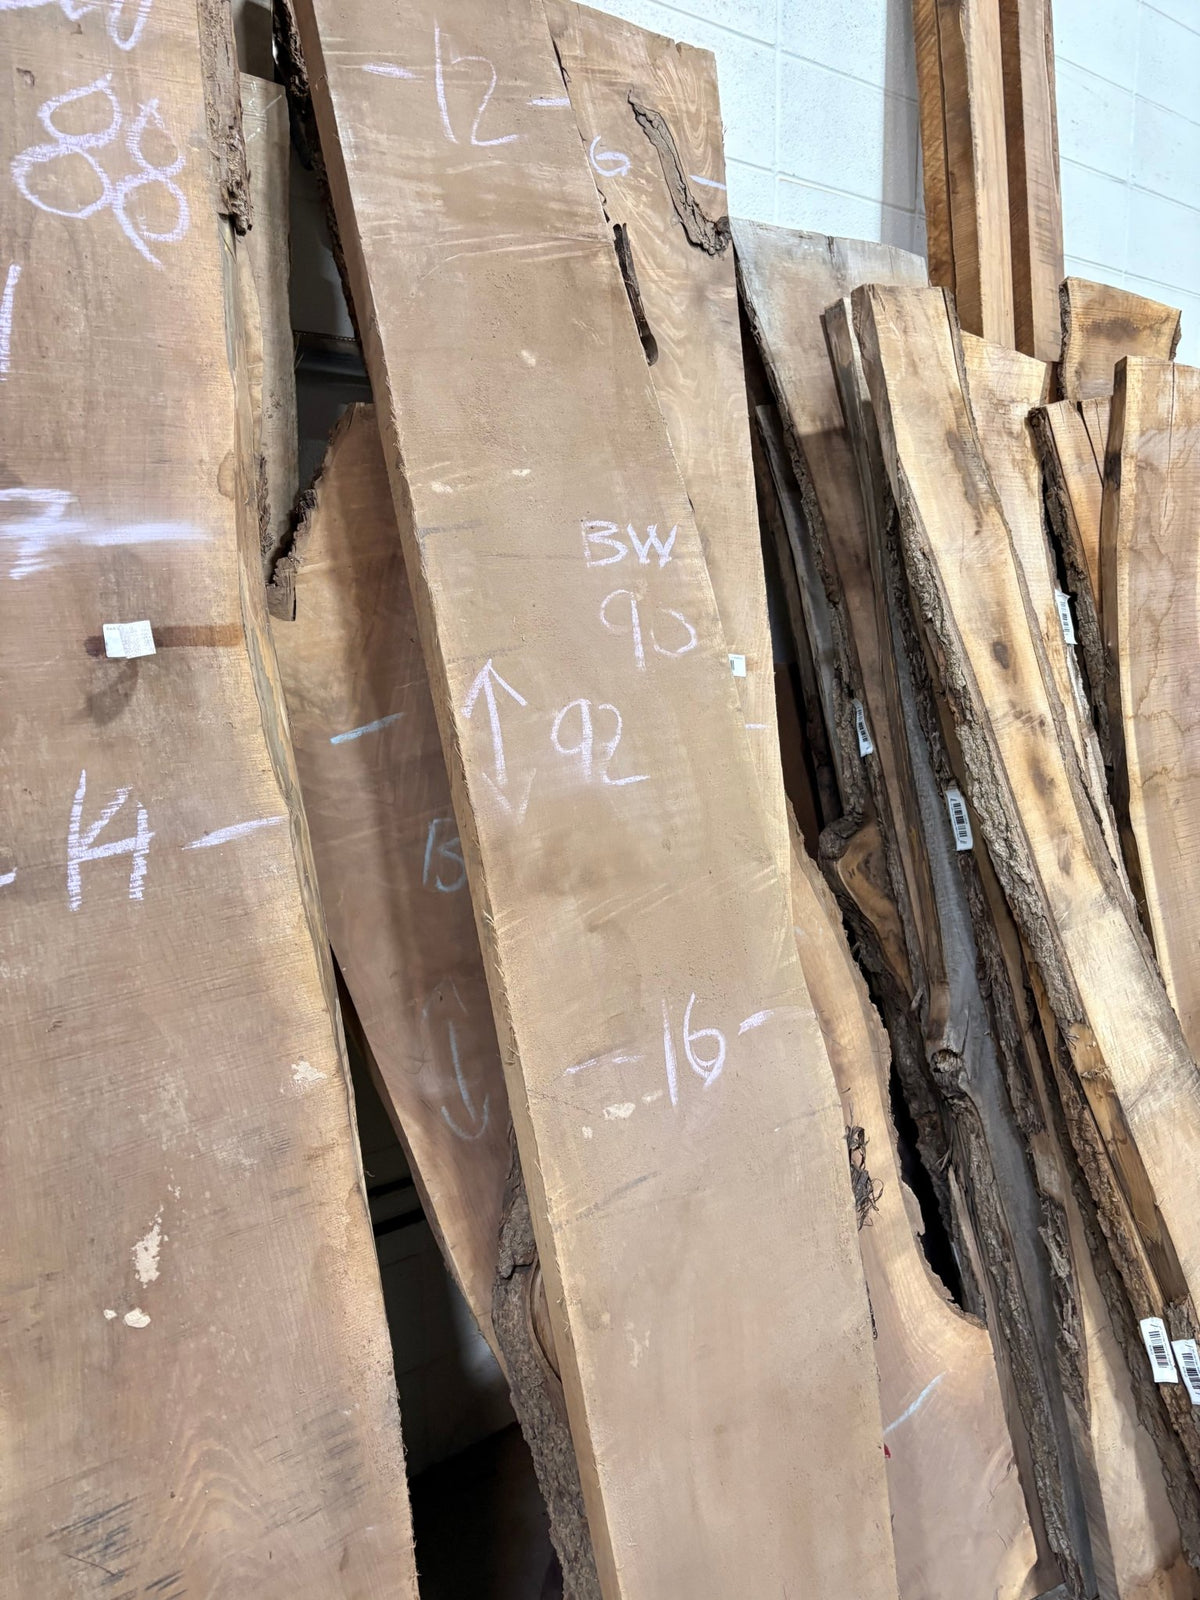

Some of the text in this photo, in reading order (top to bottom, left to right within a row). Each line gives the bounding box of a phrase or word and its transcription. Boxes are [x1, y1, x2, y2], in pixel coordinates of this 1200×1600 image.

[433, 25, 526, 146] 12
[580, 519, 678, 568] BW
[600, 588, 697, 671] 90
[551, 698, 650, 786] 92
[661, 991, 726, 1106] 16
